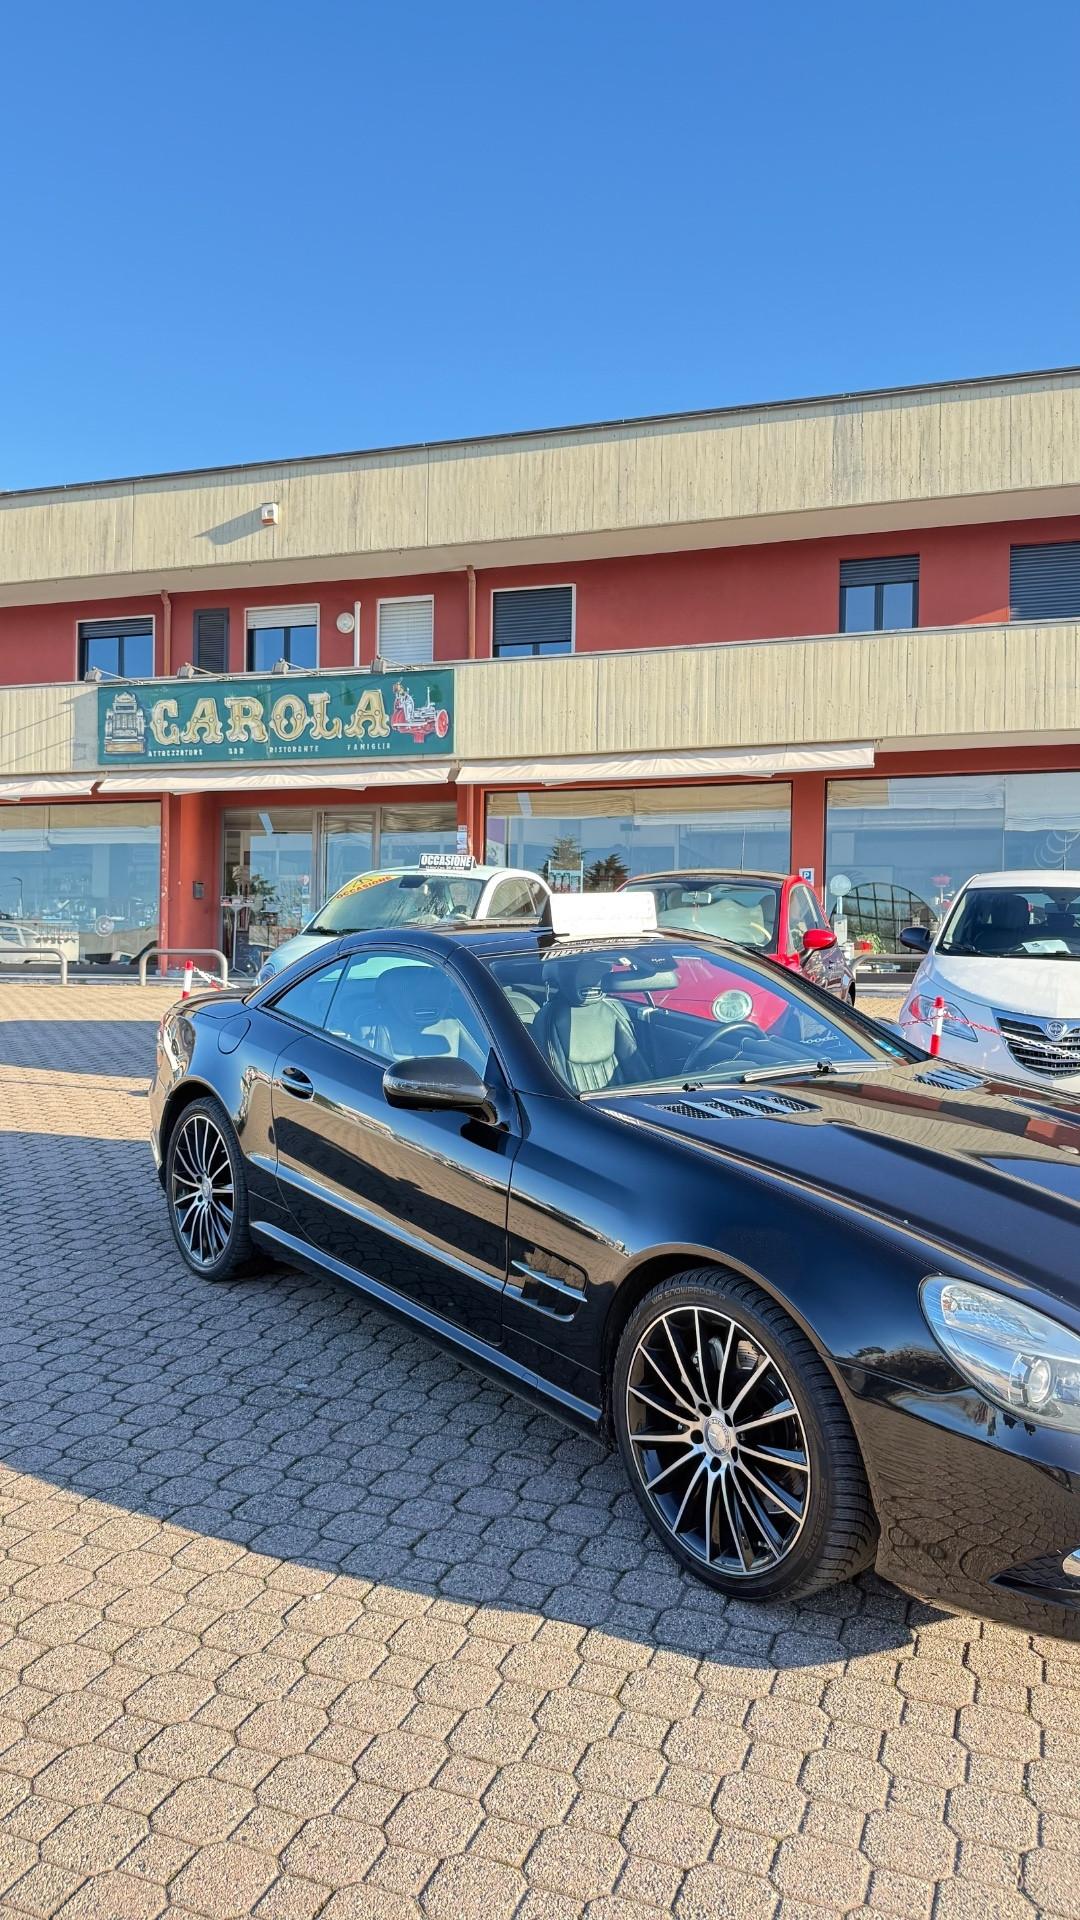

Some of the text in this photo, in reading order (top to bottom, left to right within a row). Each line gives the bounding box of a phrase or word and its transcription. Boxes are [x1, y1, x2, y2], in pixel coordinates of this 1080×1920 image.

[150, 688, 391, 746] CAROLA
[269, 745, 320, 753] RISTORANTE
[347, 742, 391, 751] FAMIGLIA
[420, 855, 472, 867] OCCASIONE
[336, 876, 391, 899] OCCASIONE
